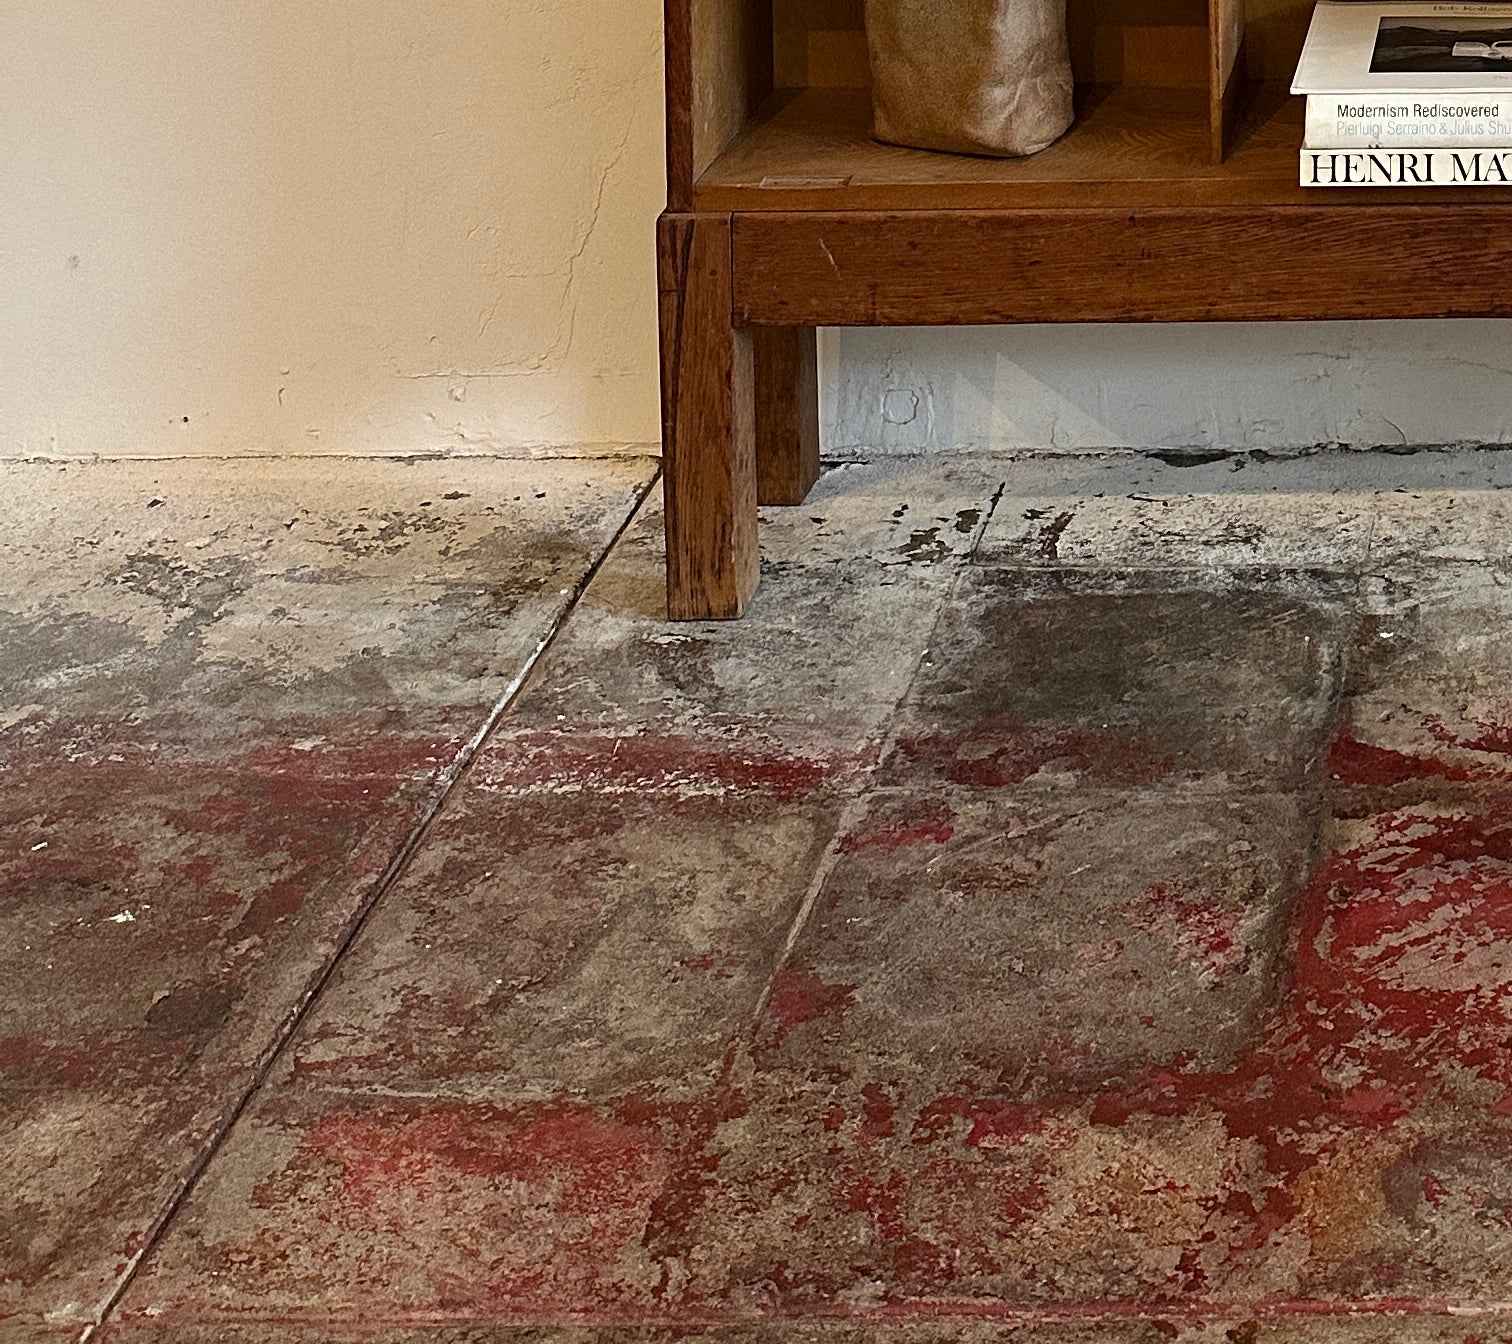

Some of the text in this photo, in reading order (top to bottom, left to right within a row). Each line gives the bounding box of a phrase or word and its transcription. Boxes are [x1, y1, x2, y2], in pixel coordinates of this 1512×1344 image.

[1337, 103, 1499, 118] Modernism Rediscovered
[1337, 120, 1382, 139] Pierluigi
[1387, 120, 1436, 136] Serraino
[1438, 121, 1448, 135] &
[1450, 120, 1485, 136] Julius
[1310, 153, 1436, 184] HENRI
